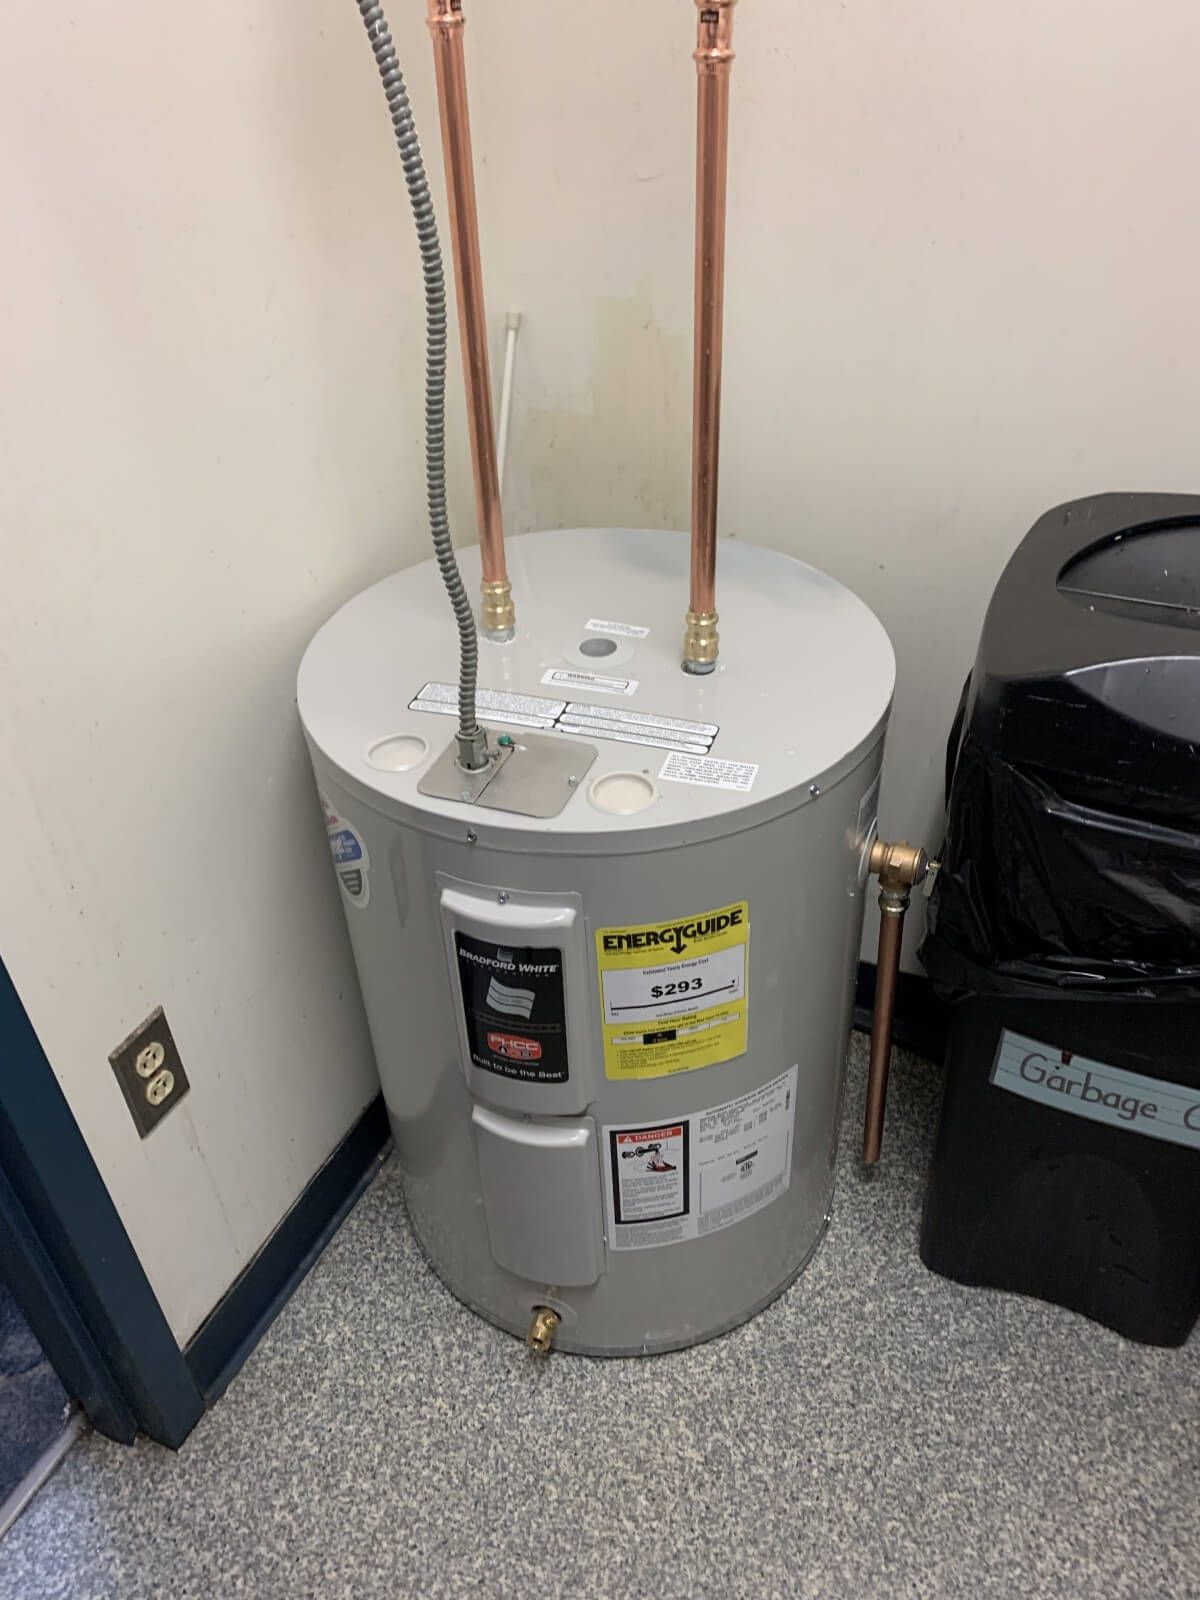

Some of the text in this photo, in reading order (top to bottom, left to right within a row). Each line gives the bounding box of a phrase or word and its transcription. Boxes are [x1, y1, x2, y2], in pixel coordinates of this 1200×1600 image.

[603, 909, 743, 952] ENERGYGUIDE
[460, 947, 515, 970] BRADFORD
[519, 963, 557, 973] WHITE
[651, 977, 703, 998] $293
[493, 1062, 502, 1071] to
[505, 1065, 517, 1074] be
[520, 1069, 535, 1078] the
[539, 1071, 562, 1079] Best
[1020, 1052, 1158, 1121] Garbage
[635, 1130, 673, 1141] DANGER
